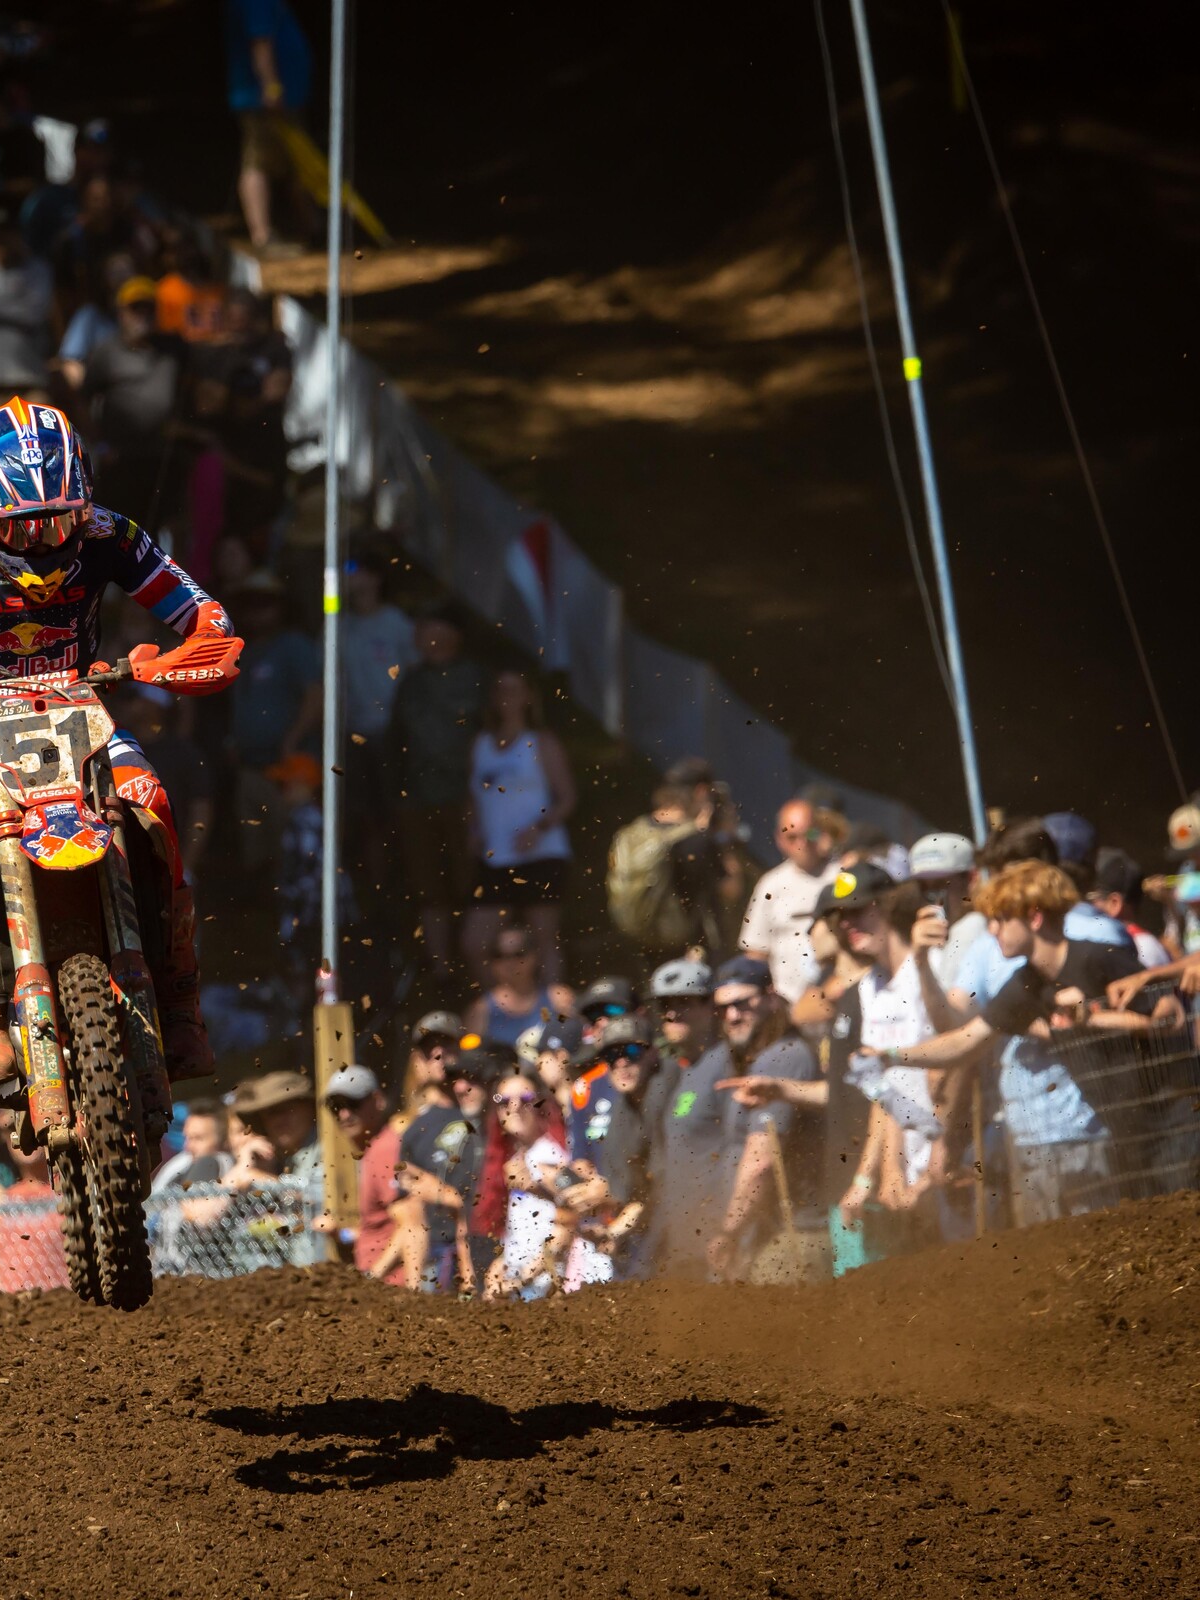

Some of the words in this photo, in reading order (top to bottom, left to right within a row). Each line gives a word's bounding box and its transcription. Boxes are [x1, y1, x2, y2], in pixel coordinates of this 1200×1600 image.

[22, 449, 42, 462] PPG
[29, 642, 79, 677] Bull
[16, 704, 30, 713] OIL
[32, 787, 77, 799] GASGAS
